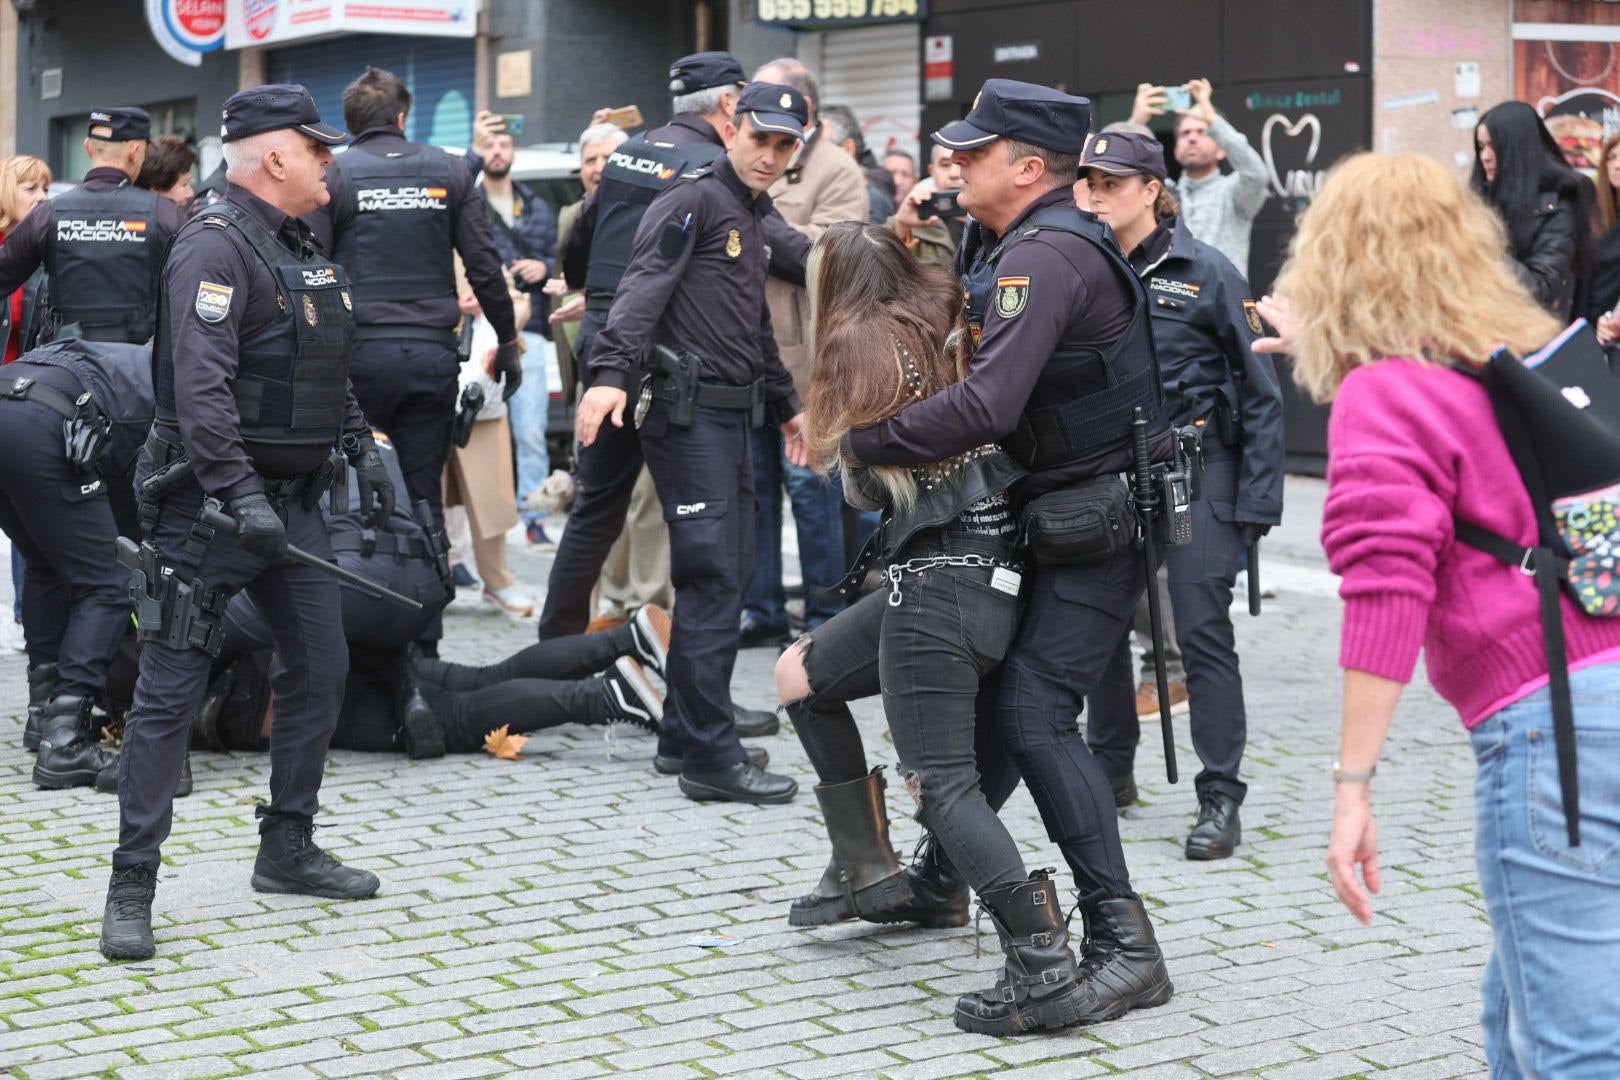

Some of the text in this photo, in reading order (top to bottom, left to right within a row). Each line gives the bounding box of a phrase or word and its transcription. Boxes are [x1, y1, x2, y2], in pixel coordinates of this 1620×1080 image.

[607, 152, 663, 177] POLICIA
[357, 187, 430, 200] POLICIA
[358, 198, 447, 211] NACIONAL
[57, 220, 127, 231] POLICIA
[57, 231, 146, 242] NACIONAL
[1151, 277, 1189, 289] POLICIA
[1150, 284, 1199, 298] NACIONAL
[676, 502, 706, 515] CNP
